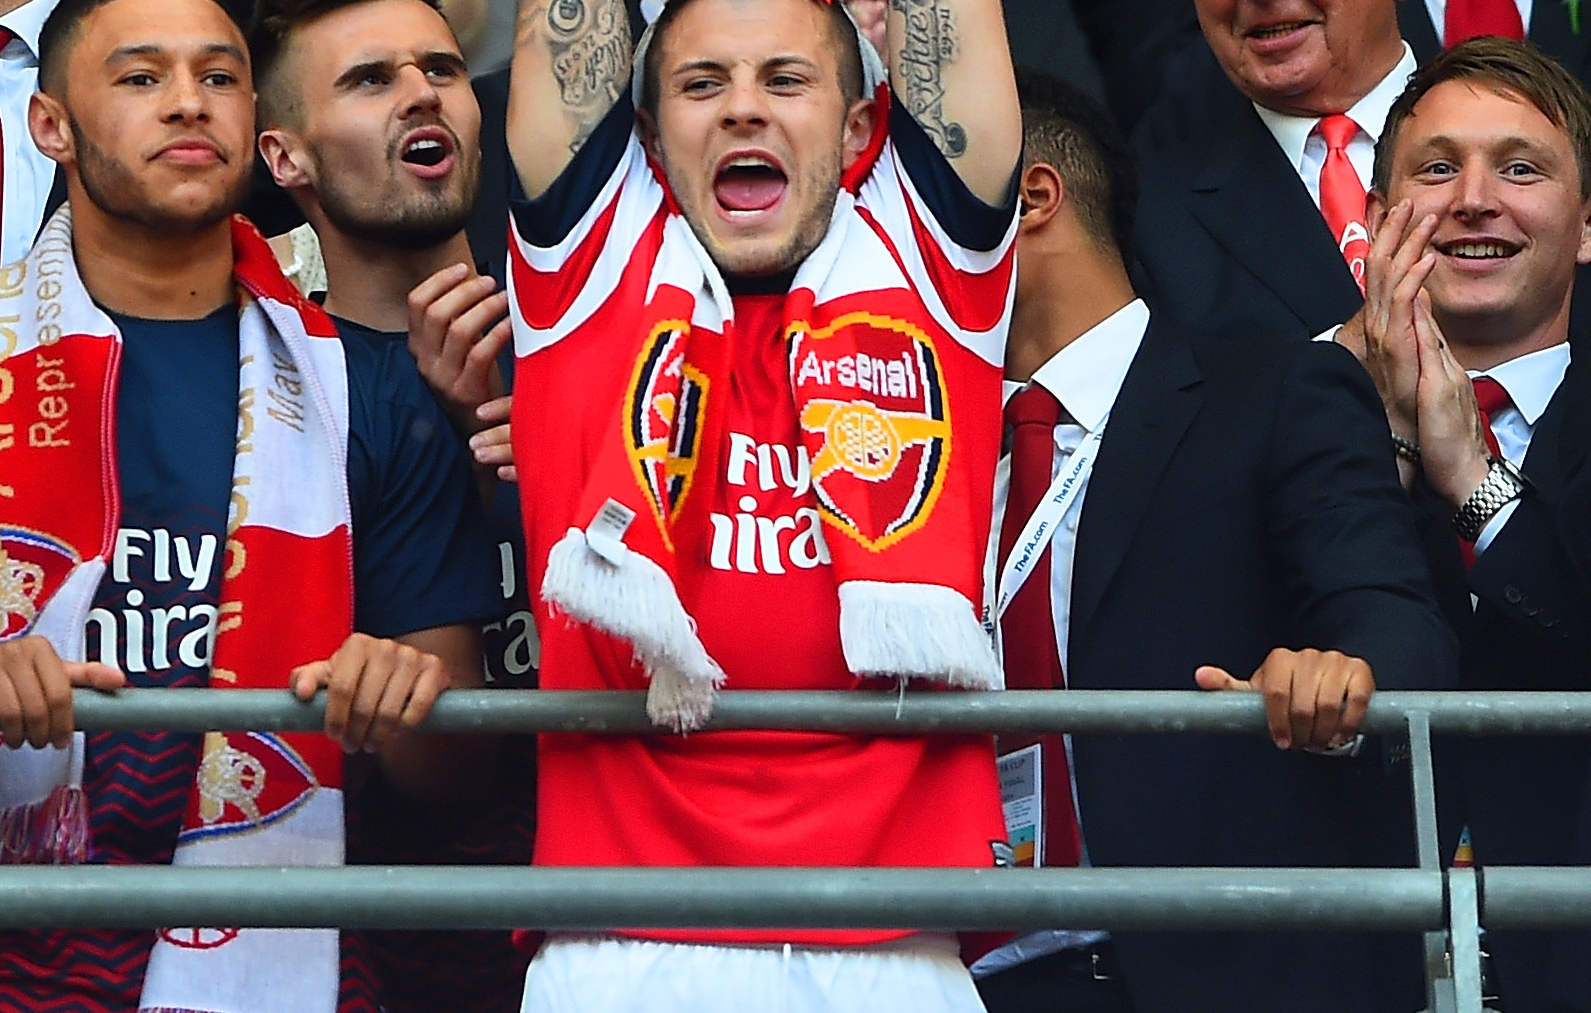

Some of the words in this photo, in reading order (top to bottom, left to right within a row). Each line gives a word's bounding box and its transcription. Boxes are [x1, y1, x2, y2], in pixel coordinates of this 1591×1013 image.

[797, 350, 917, 399] Arsenal
[727, 432, 811, 498] Fly
[113, 528, 217, 591] Fly
